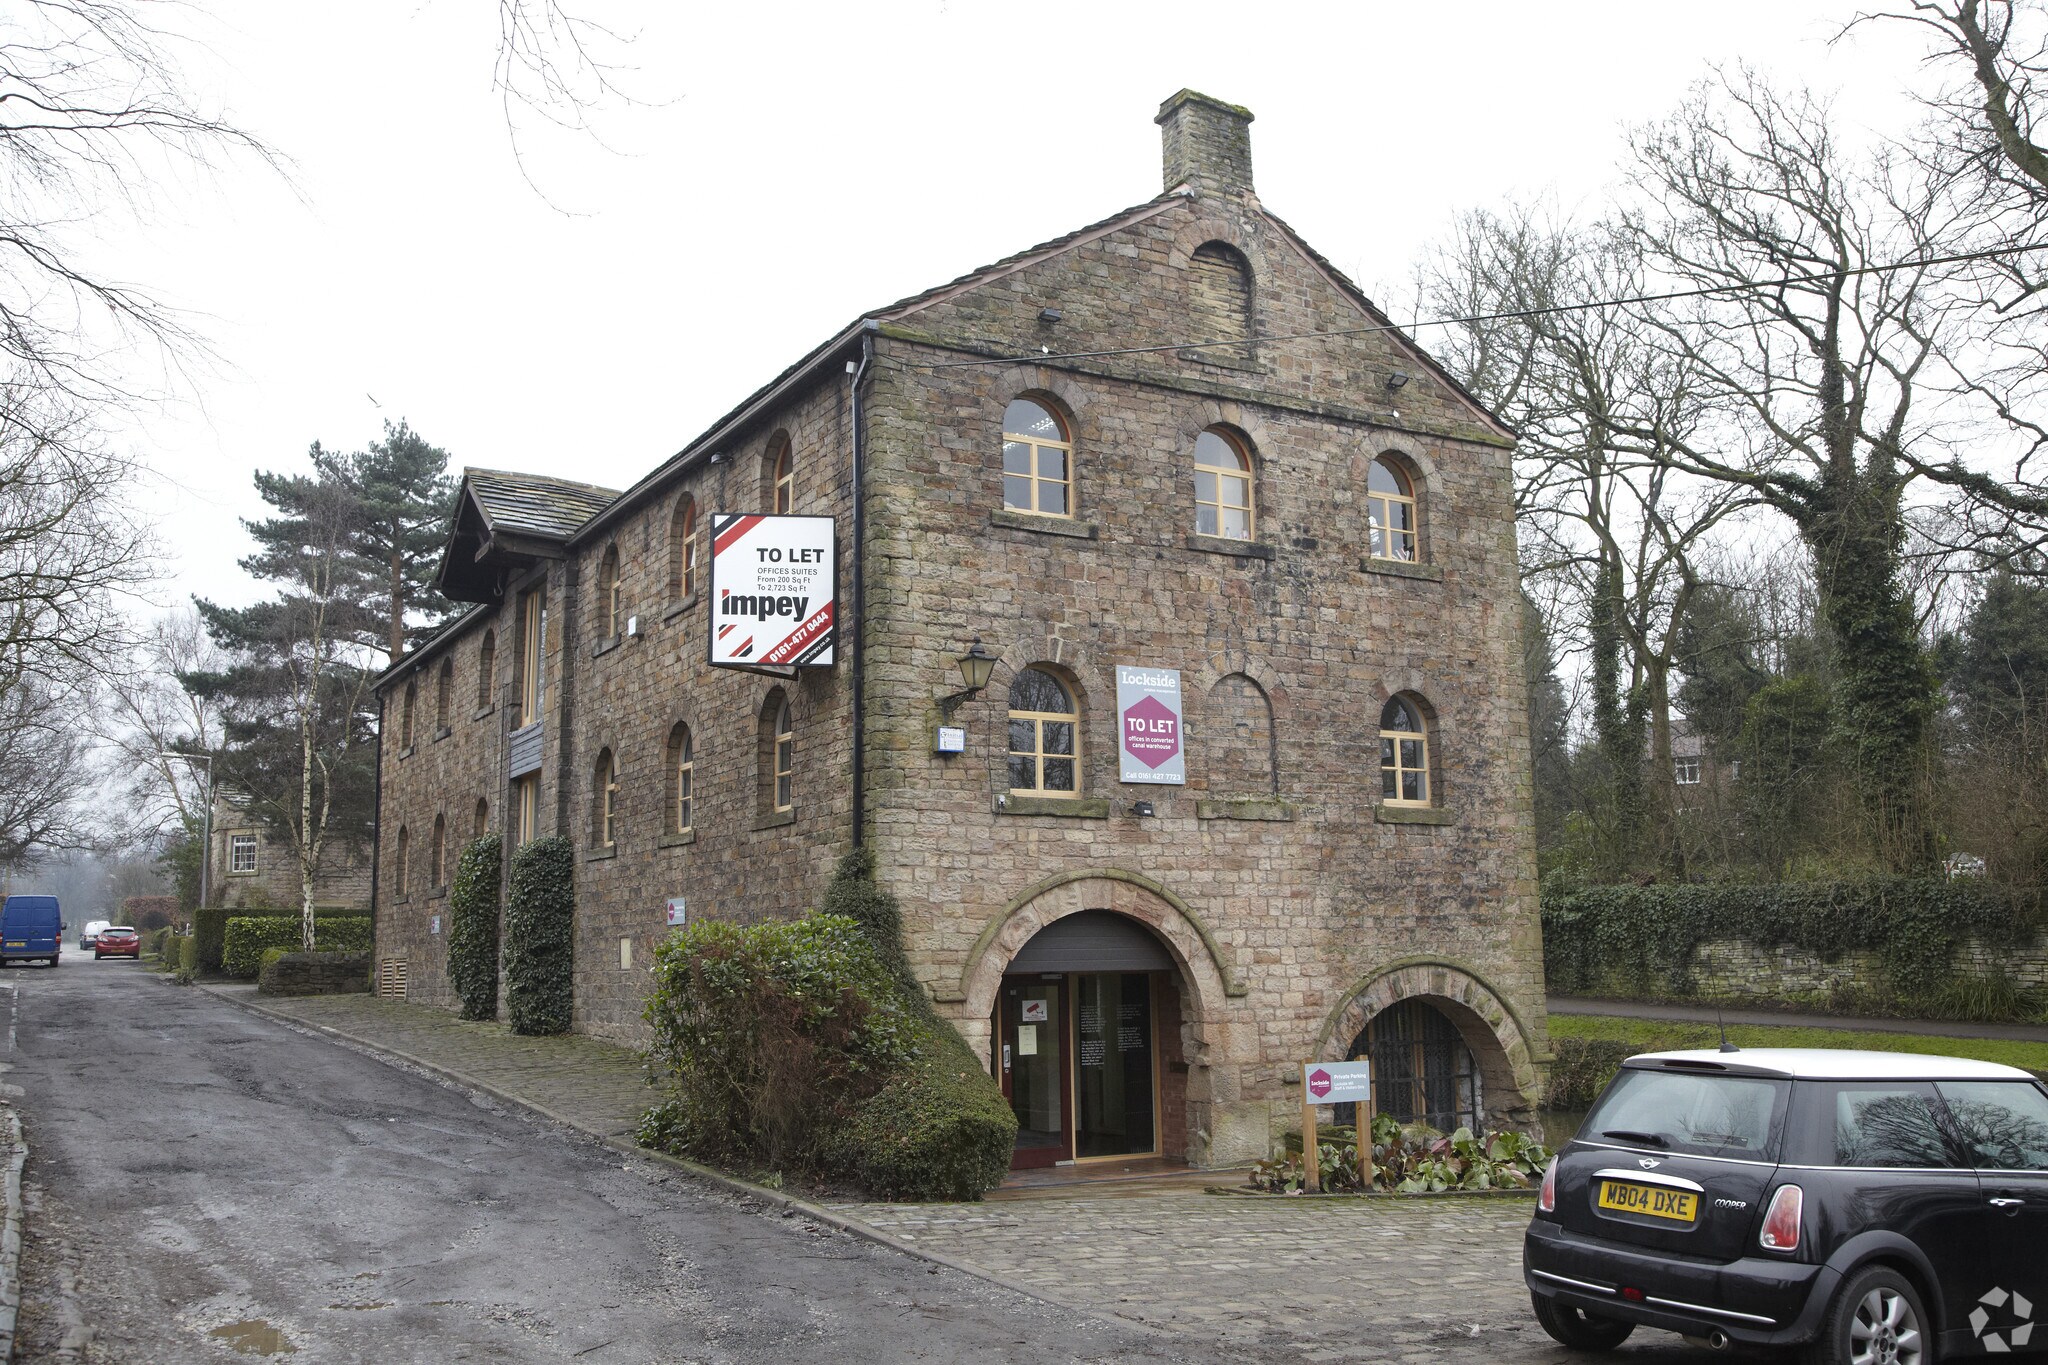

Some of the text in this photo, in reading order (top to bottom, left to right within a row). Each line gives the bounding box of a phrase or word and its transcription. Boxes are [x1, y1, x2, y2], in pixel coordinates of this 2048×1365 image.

[756, 548, 824, 563] TO LET
[757, 567, 818, 576] OFFICES SUITES
[757, 575, 776, 583] From
[791, 576, 802, 584] Sq
[803, 576, 811, 584] Ft
[757, 583, 807, 592] To 2,723 Sq Ft
[722, 589, 809, 622] impey
[769, 627, 808, 662] 0161-477
[806, 611, 829, 632] 0444
[800, 637, 831, 664] www.impey.co.uk
[1121, 671, 1176, 688] Lockside
[1127, 717, 1174, 733] TO LET
[1125, 771, 1138, 779] Call
[1152, 772, 1165, 780] 427
[1165, 773, 1181, 781] 7723
[1606, 1184, 1690, 1216] MB04 DXE
[1714, 1198, 1747, 1211] COOPER
